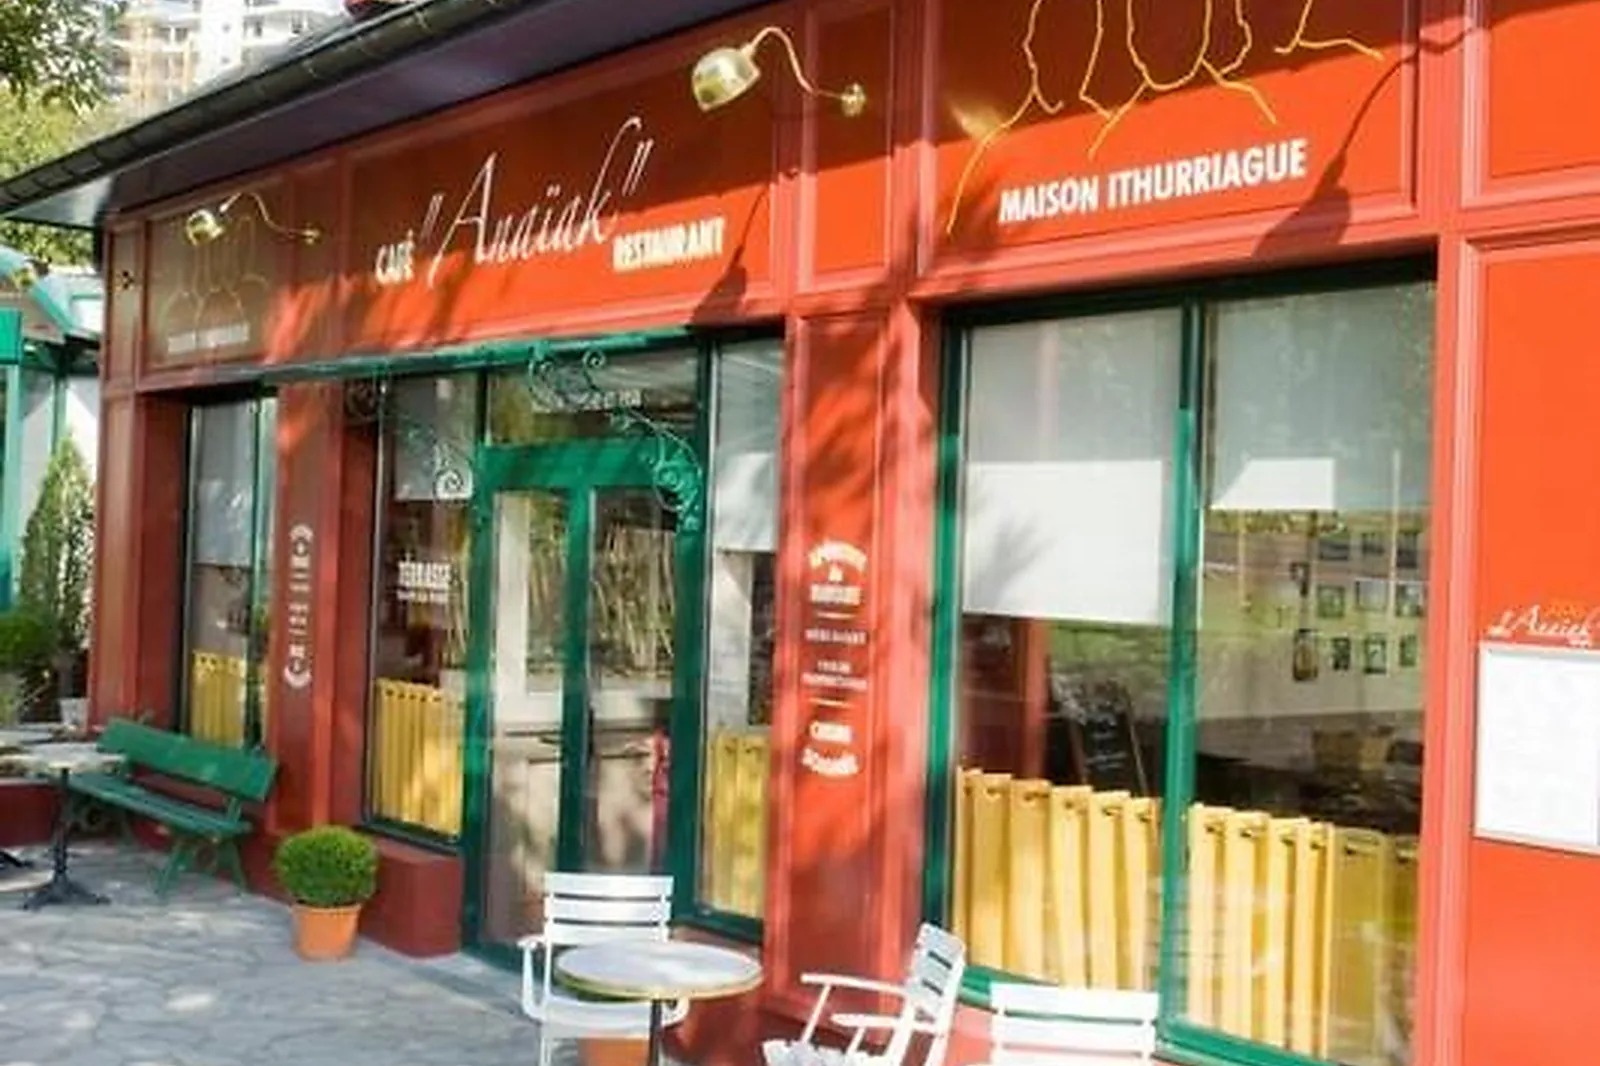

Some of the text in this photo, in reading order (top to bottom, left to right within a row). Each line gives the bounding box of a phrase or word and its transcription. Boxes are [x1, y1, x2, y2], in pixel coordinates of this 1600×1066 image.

[998, 138, 1307, 224] MAISON ITHURRIAGUE
[375, 229, 414, 284] CAFÉ
[613, 216, 724, 273] RESTAURANT
